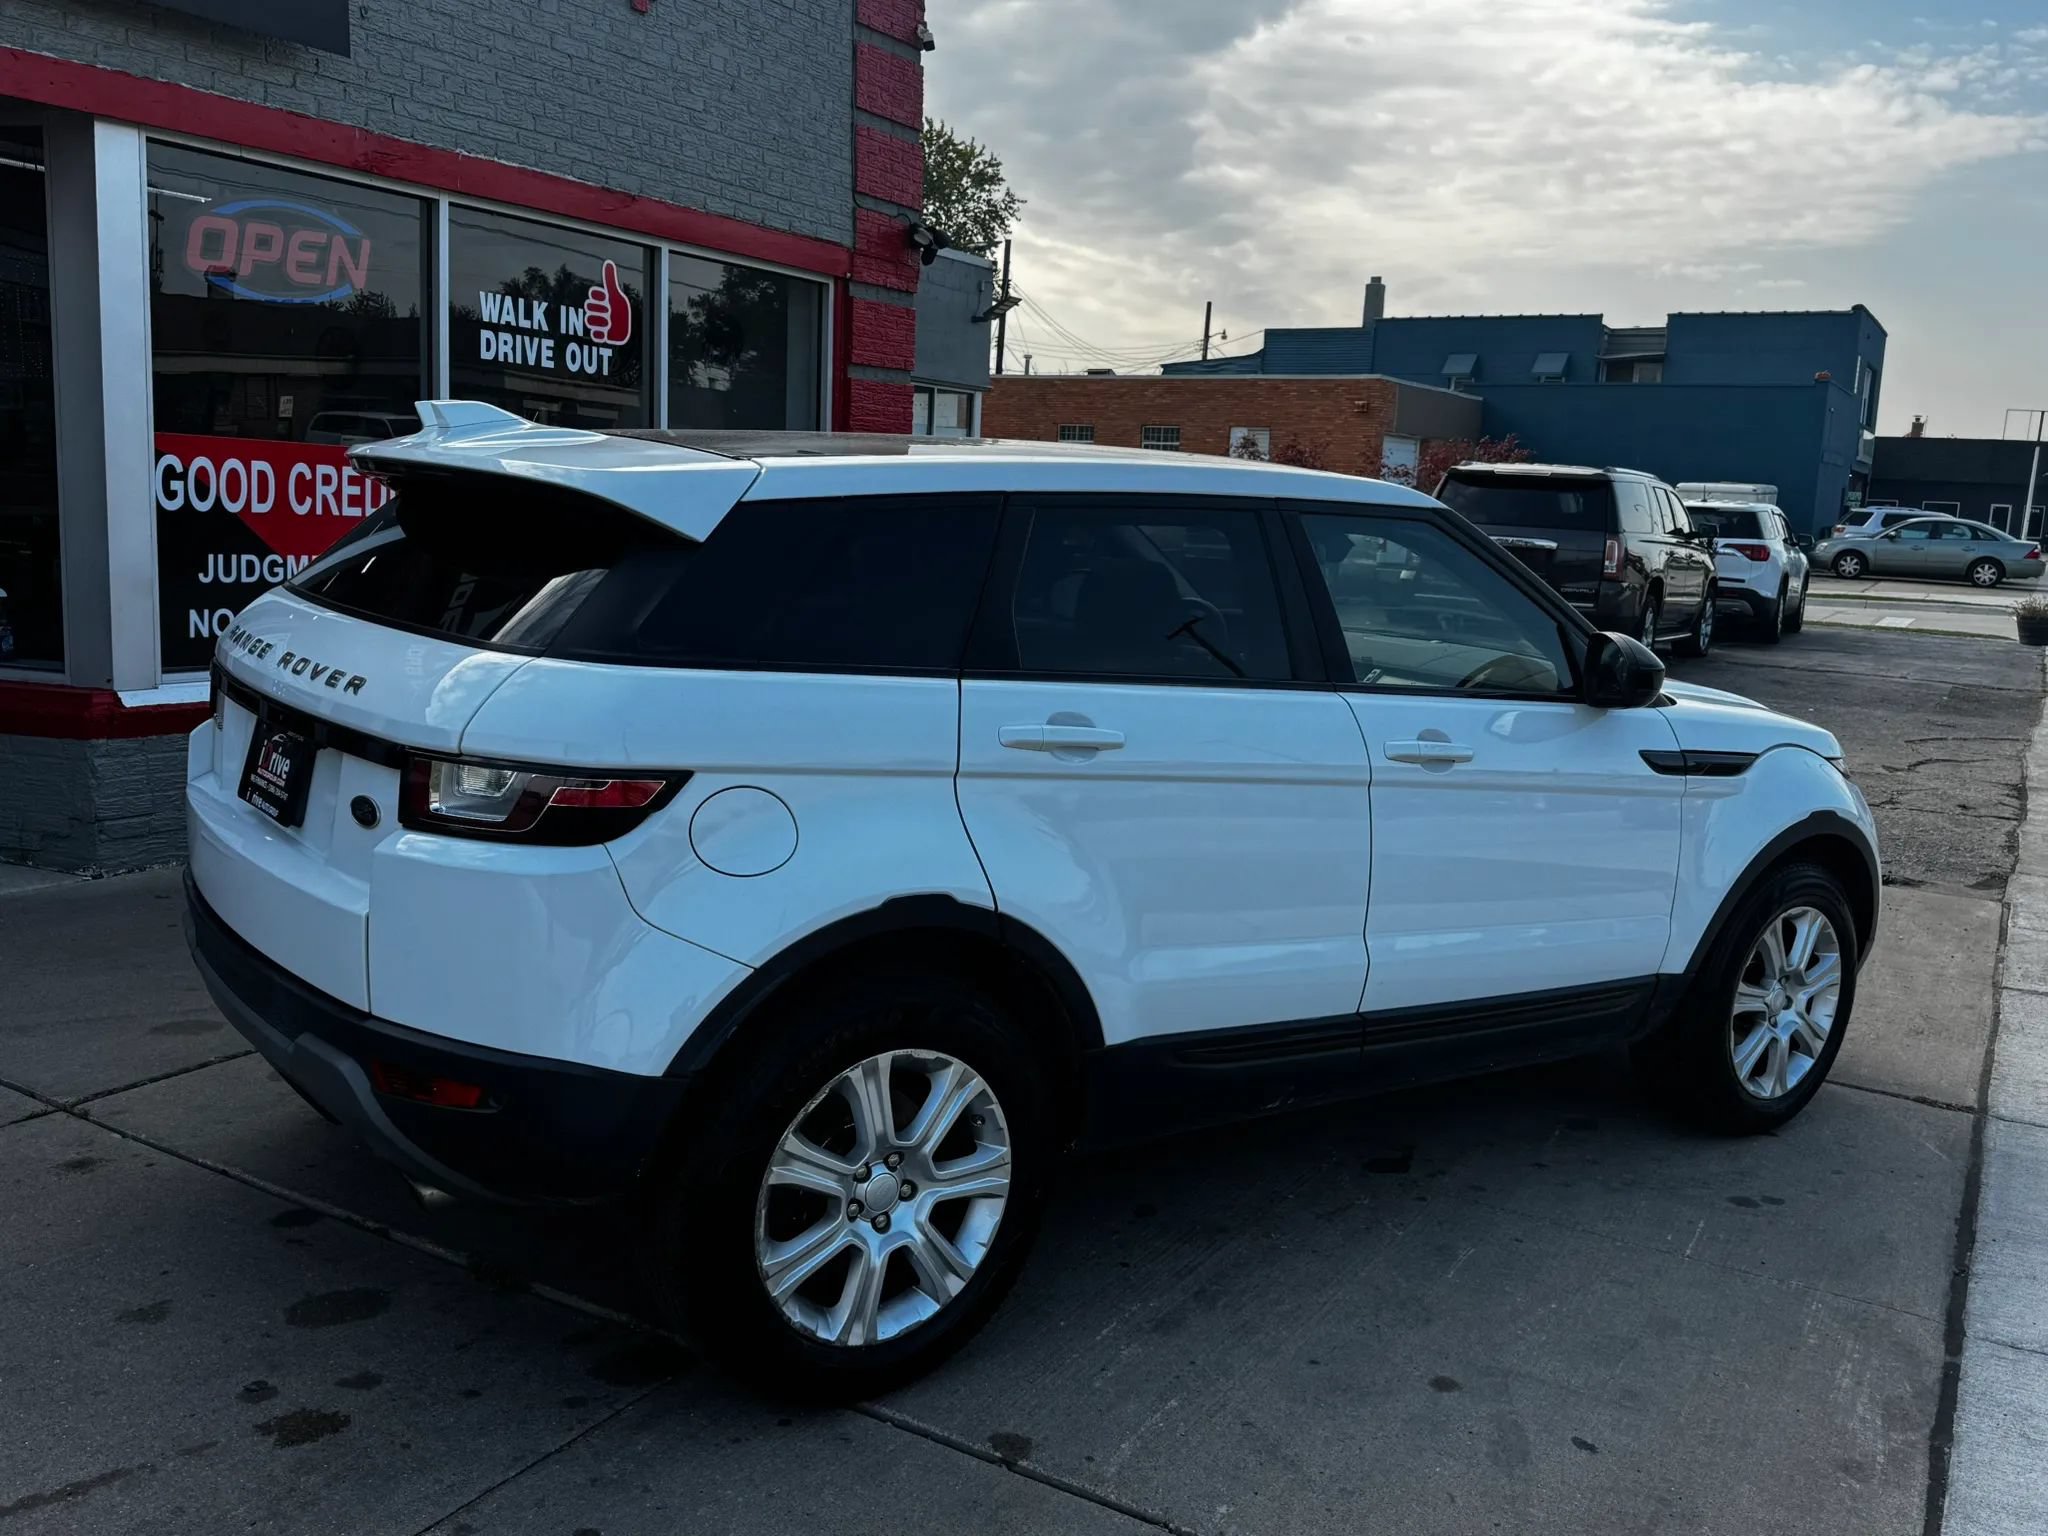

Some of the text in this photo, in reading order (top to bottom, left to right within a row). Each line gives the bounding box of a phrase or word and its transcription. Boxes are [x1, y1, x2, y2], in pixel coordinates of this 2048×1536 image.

[186, 215, 371, 289] OPEN
[479, 291, 584, 337] WALK IN
[480, 329, 613, 376] DRIVE OUT
[155, 454, 397, 517] GOOD CRED
[198, 554, 318, 584] JUDGM
[229, 625, 368, 696] RANGE ROVER
